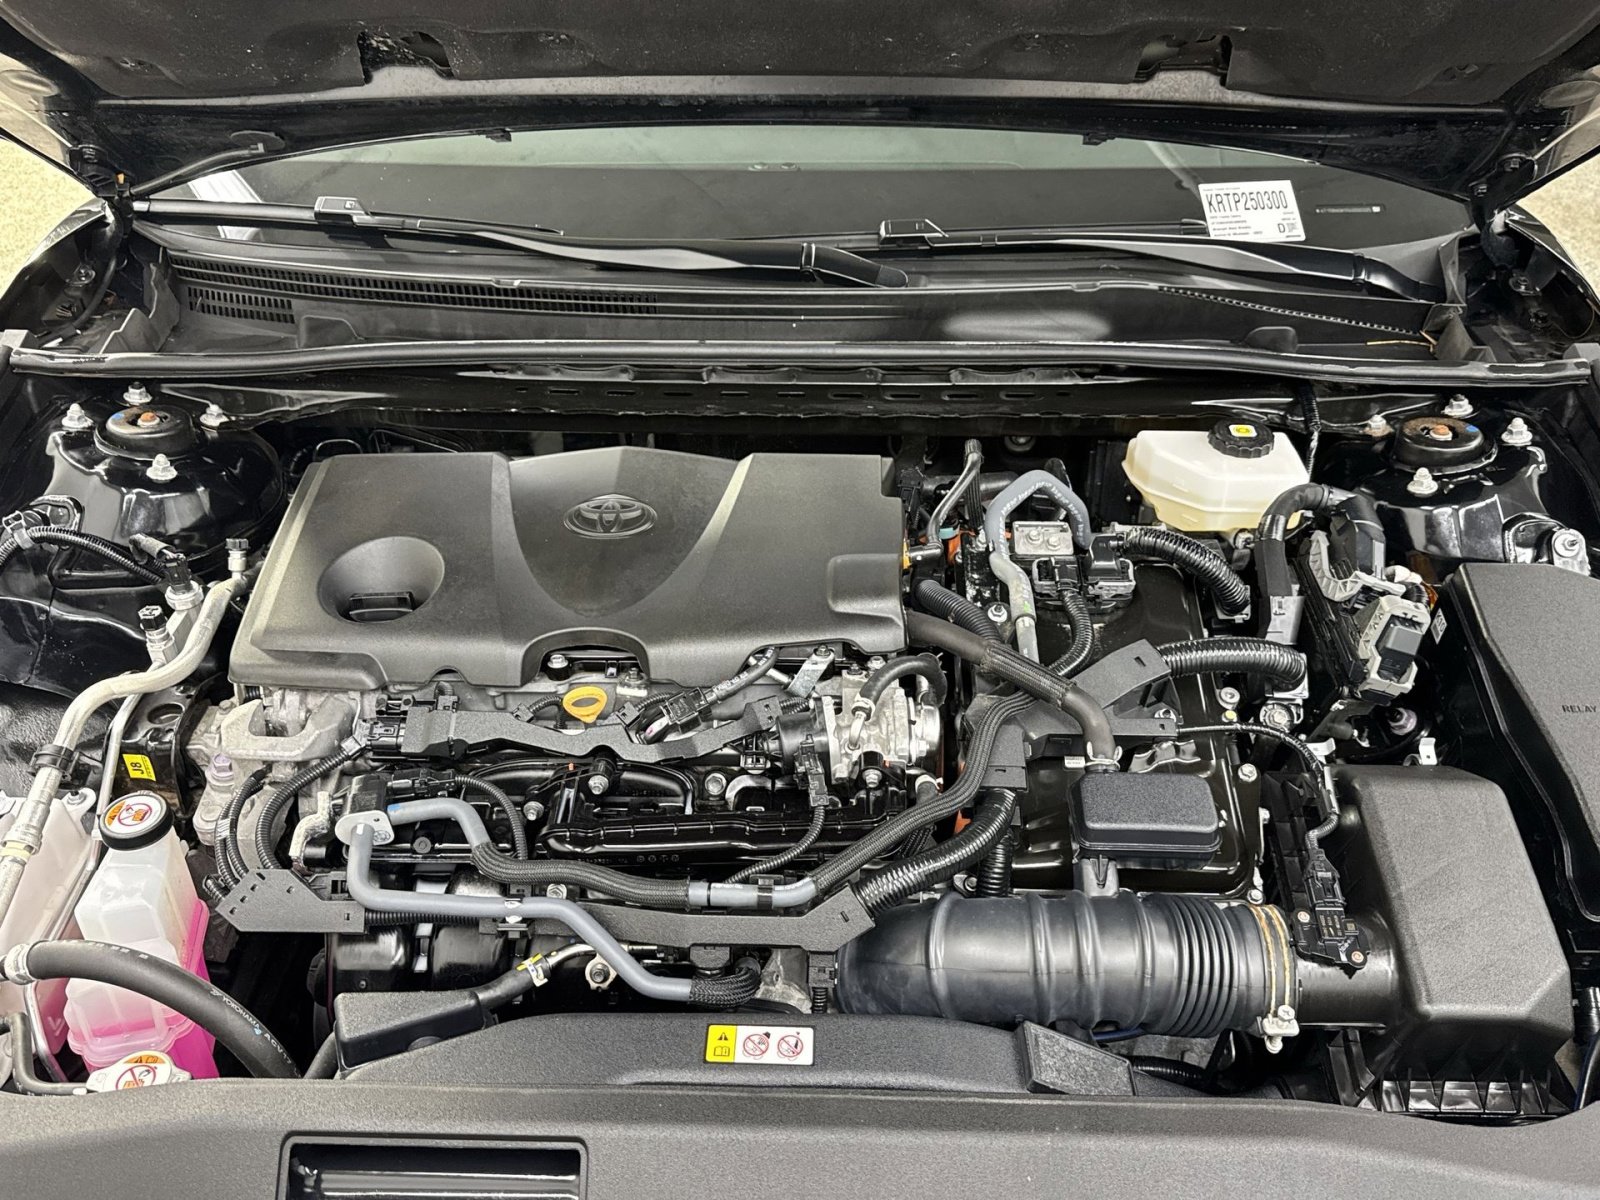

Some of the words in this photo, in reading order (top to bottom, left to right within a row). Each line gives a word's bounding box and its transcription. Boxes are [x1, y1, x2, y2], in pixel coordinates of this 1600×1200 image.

[1206, 190, 1288, 213] KRTP250300
[1562, 704, 1597, 713] RELAY
[130, 762, 144, 775] J8
[223, 995, 260, 1029] YOKOHAMA
